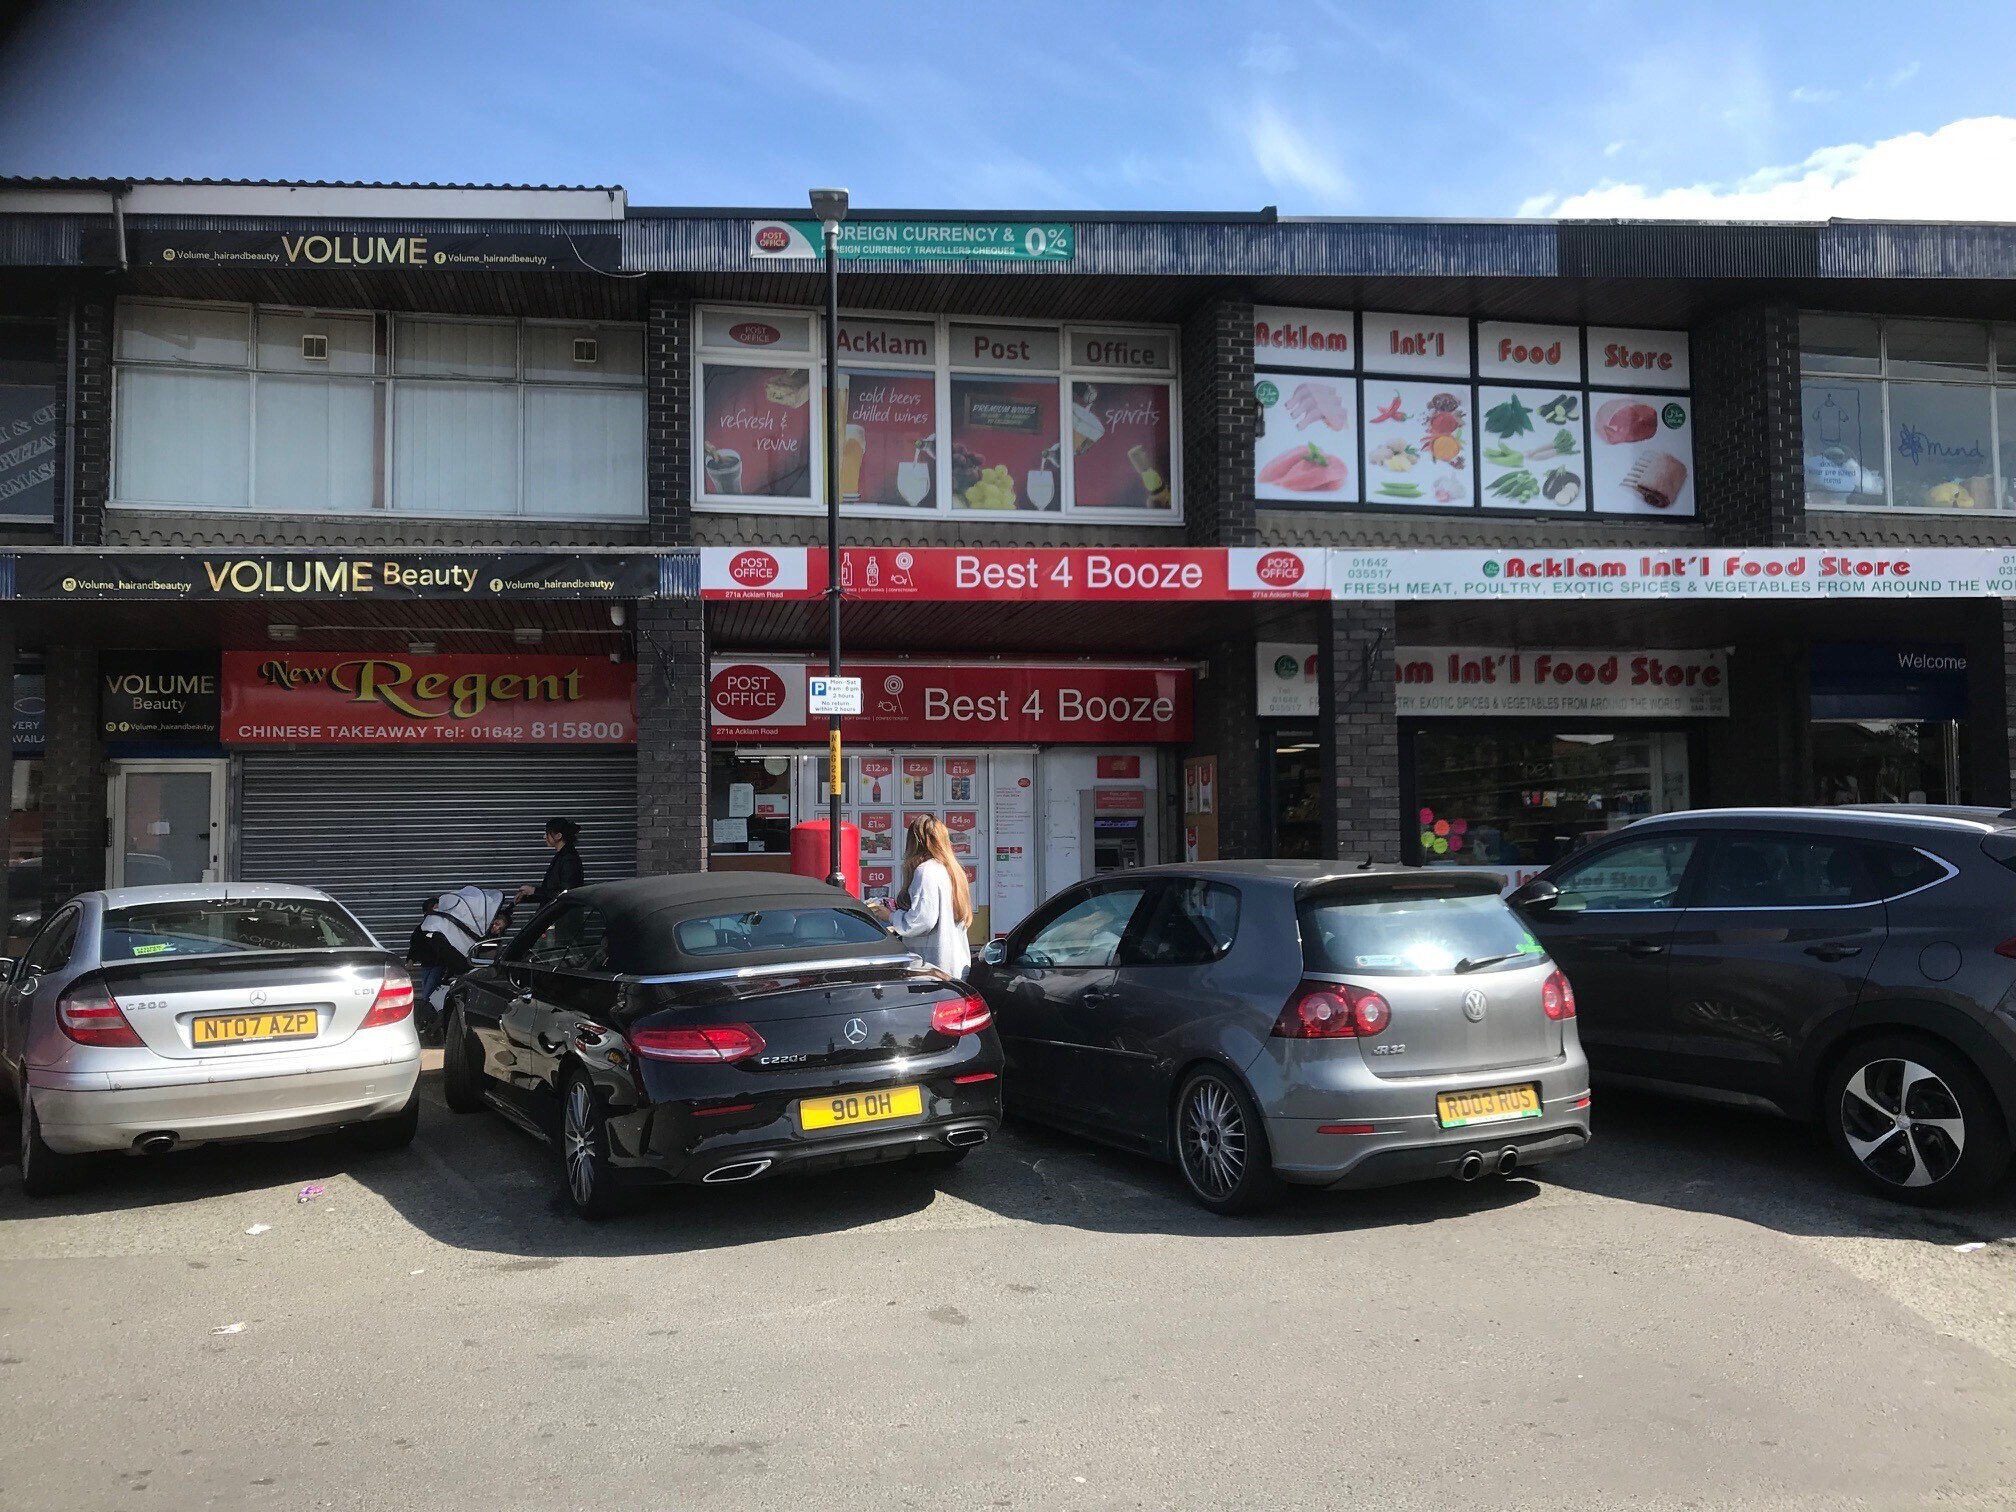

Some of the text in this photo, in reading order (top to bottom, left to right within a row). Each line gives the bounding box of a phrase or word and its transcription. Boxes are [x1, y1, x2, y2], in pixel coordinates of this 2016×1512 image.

[760, 239, 786, 247] OFFICE
[763, 232, 782, 240] POST
[902, 227, 998, 242] CURRENCY
[1003, 228, 1015, 242] &
[1024, 227, 1067, 256] 0%
[177, 236, 547, 264] Volume_hairandbeautyy VOLUME Volume_hairandbeautyy
[864, 246, 911, 254] CURRENCY
[914, 246, 970, 254] TRAVELLERS
[972, 246, 1016, 255] CHEQUES
[740, 334, 770, 342] OFFICE
[746, 326, 766, 334] POST
[838, 329, 1155, 364] Acklam Post Office
[1254, 321, 1348, 352] Acklam
[1498, 338, 1561, 365] Food
[1604, 343, 1673, 370] Store
[859, 386, 922, 406] cold beers
[720, 409, 772, 430] refresh
[852, 404, 928, 424] chilled wines
[1106, 400, 1160, 434] spirits
[756, 434, 798, 451] revive
[740, 558, 769, 568] POST
[1267, 558, 1296, 568] POST
[1352, 558, 1388, 568] 01642
[1504, 558, 1626, 578] Acklam
[1724, 556, 1806, 576] Food
[1819, 556, 1912, 577] Store
[78, 560, 614, 592] Volume_hairandbeautyy VOLUME Beauty Volume_hairandbeautyy
[734, 568, 773, 578] OFFICE
[956, 556, 1203, 589] Best 4 Booze
[1261, 568, 1299, 578] OFFICE
[1348, 570, 1392, 579] 035517
[1344, 582, 1400, 594] FRESH
[1406, 582, 1458, 595] MEAT,
[1464, 582, 1546, 595] POULTRY,
[1553, 582, 1614, 594] EXOTIC
[1621, 581, 1681, 593] SPICES
[1687, 581, 1698, 593] &
[1705, 581, 1812, 593] VEGETABLES
[1818, 581, 1866, 592] FROM
[1871, 580, 1942, 592] AROUND
[1948, 580, 1980, 592] THE
[1898, 652, 1966, 670] Welcome
[1535, 654, 1618, 685] Food
[1631, 656, 1721, 686] Store
[106, 675, 214, 694] VOLUME
[260, 659, 585, 720] New Regent
[727, 676, 770, 690] POST
[815, 684, 824, 695] P
[133, 697, 186, 713] Beauty
[716, 692, 776, 706] OFFICE
[924, 688, 1174, 722] Best 4 Booze
[1420, 696, 1453, 710] EXOTIC
[1456, 696, 1490, 710] SPICES
[1502, 696, 1560, 710] VEGETABLES
[1562, 697, 1588, 710] FROM
[238, 722, 624, 740] CHINESE TAKEAWAY Tel: 01642 815800
[869, 873, 884, 881] £10
[354, 988, 375, 996] CDI
[204, 1014, 308, 1039] NT07 AZP
[832, 1093, 892, 1121] 90 OH
[1448, 1087, 1532, 1118] RD03 RUS
